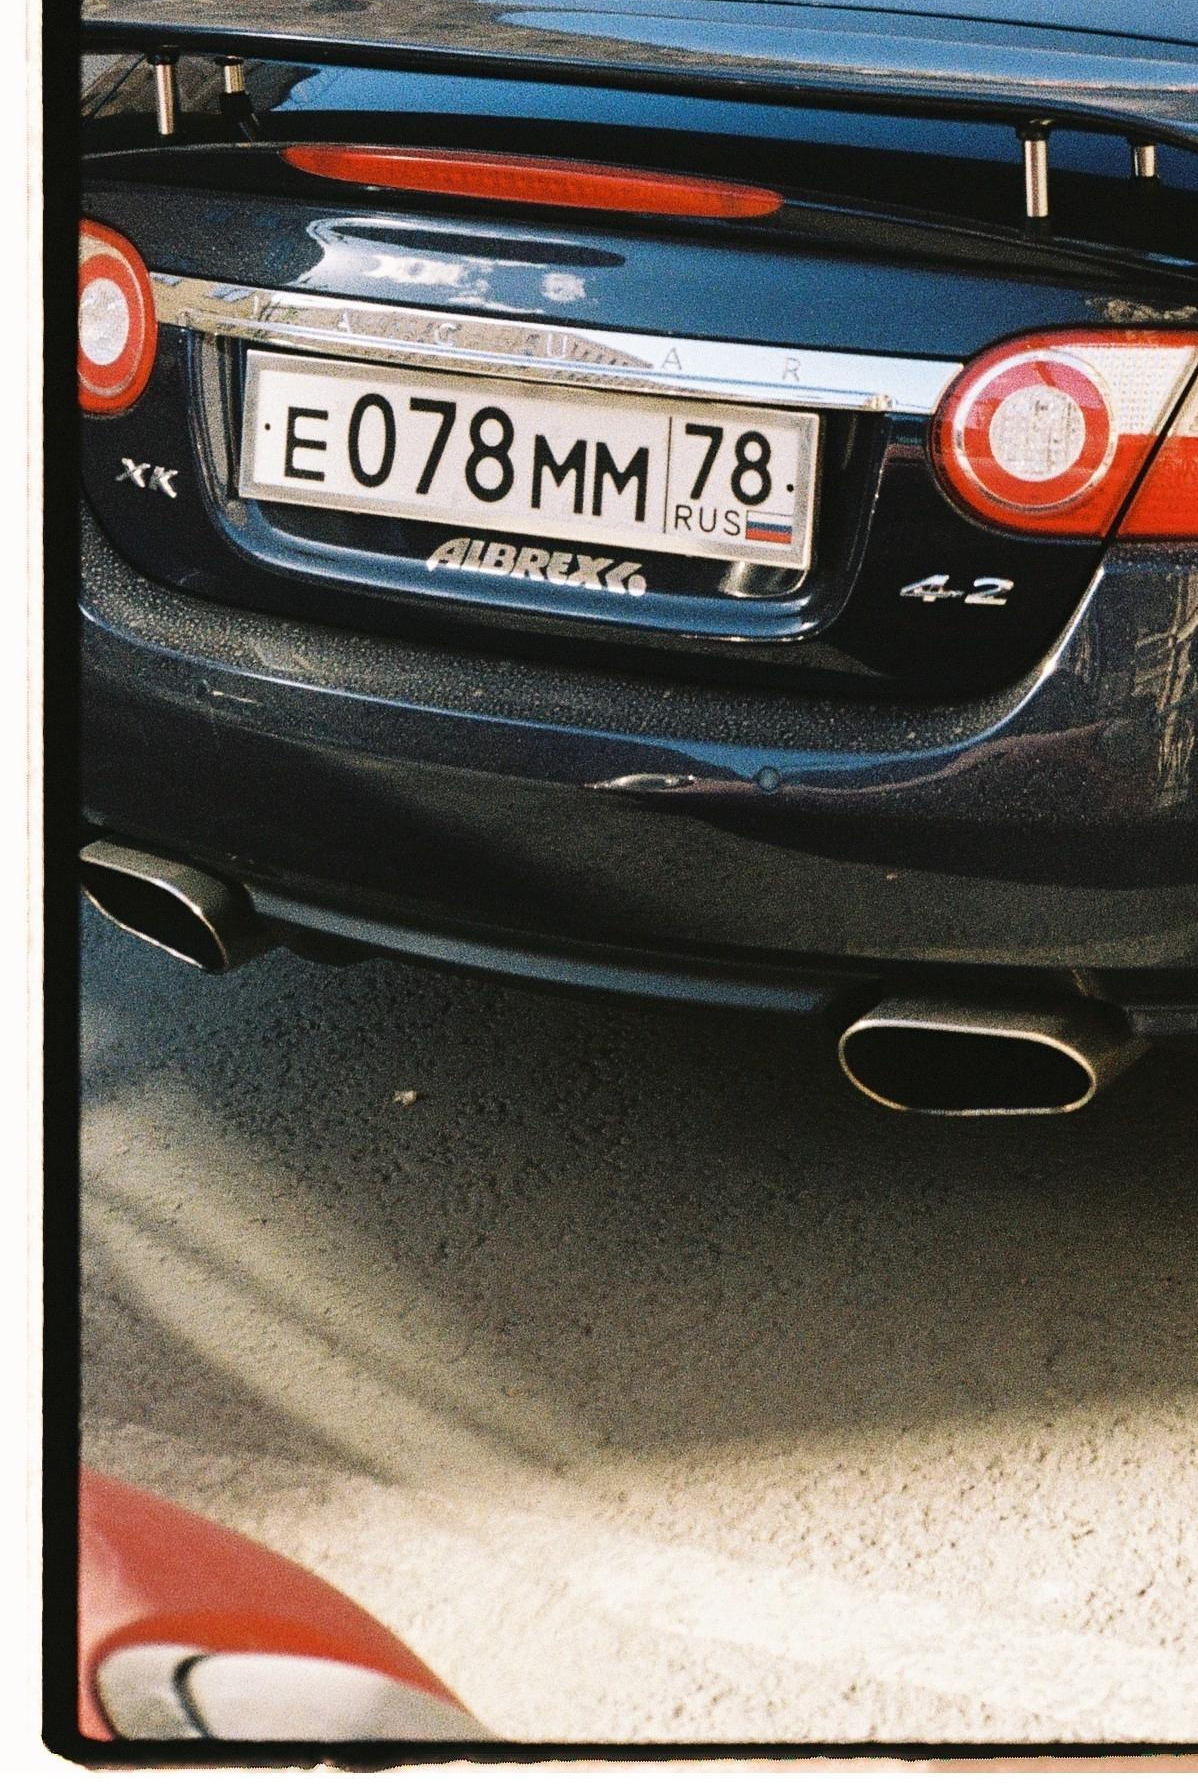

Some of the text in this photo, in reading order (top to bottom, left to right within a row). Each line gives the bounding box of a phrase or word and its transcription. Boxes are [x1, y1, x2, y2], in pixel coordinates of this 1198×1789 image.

[115, 457, 179, 499] XK
[284, 392, 649, 522] E078MM
[685, 422, 772, 506] 78
[674, 504, 741, 536] RUS
